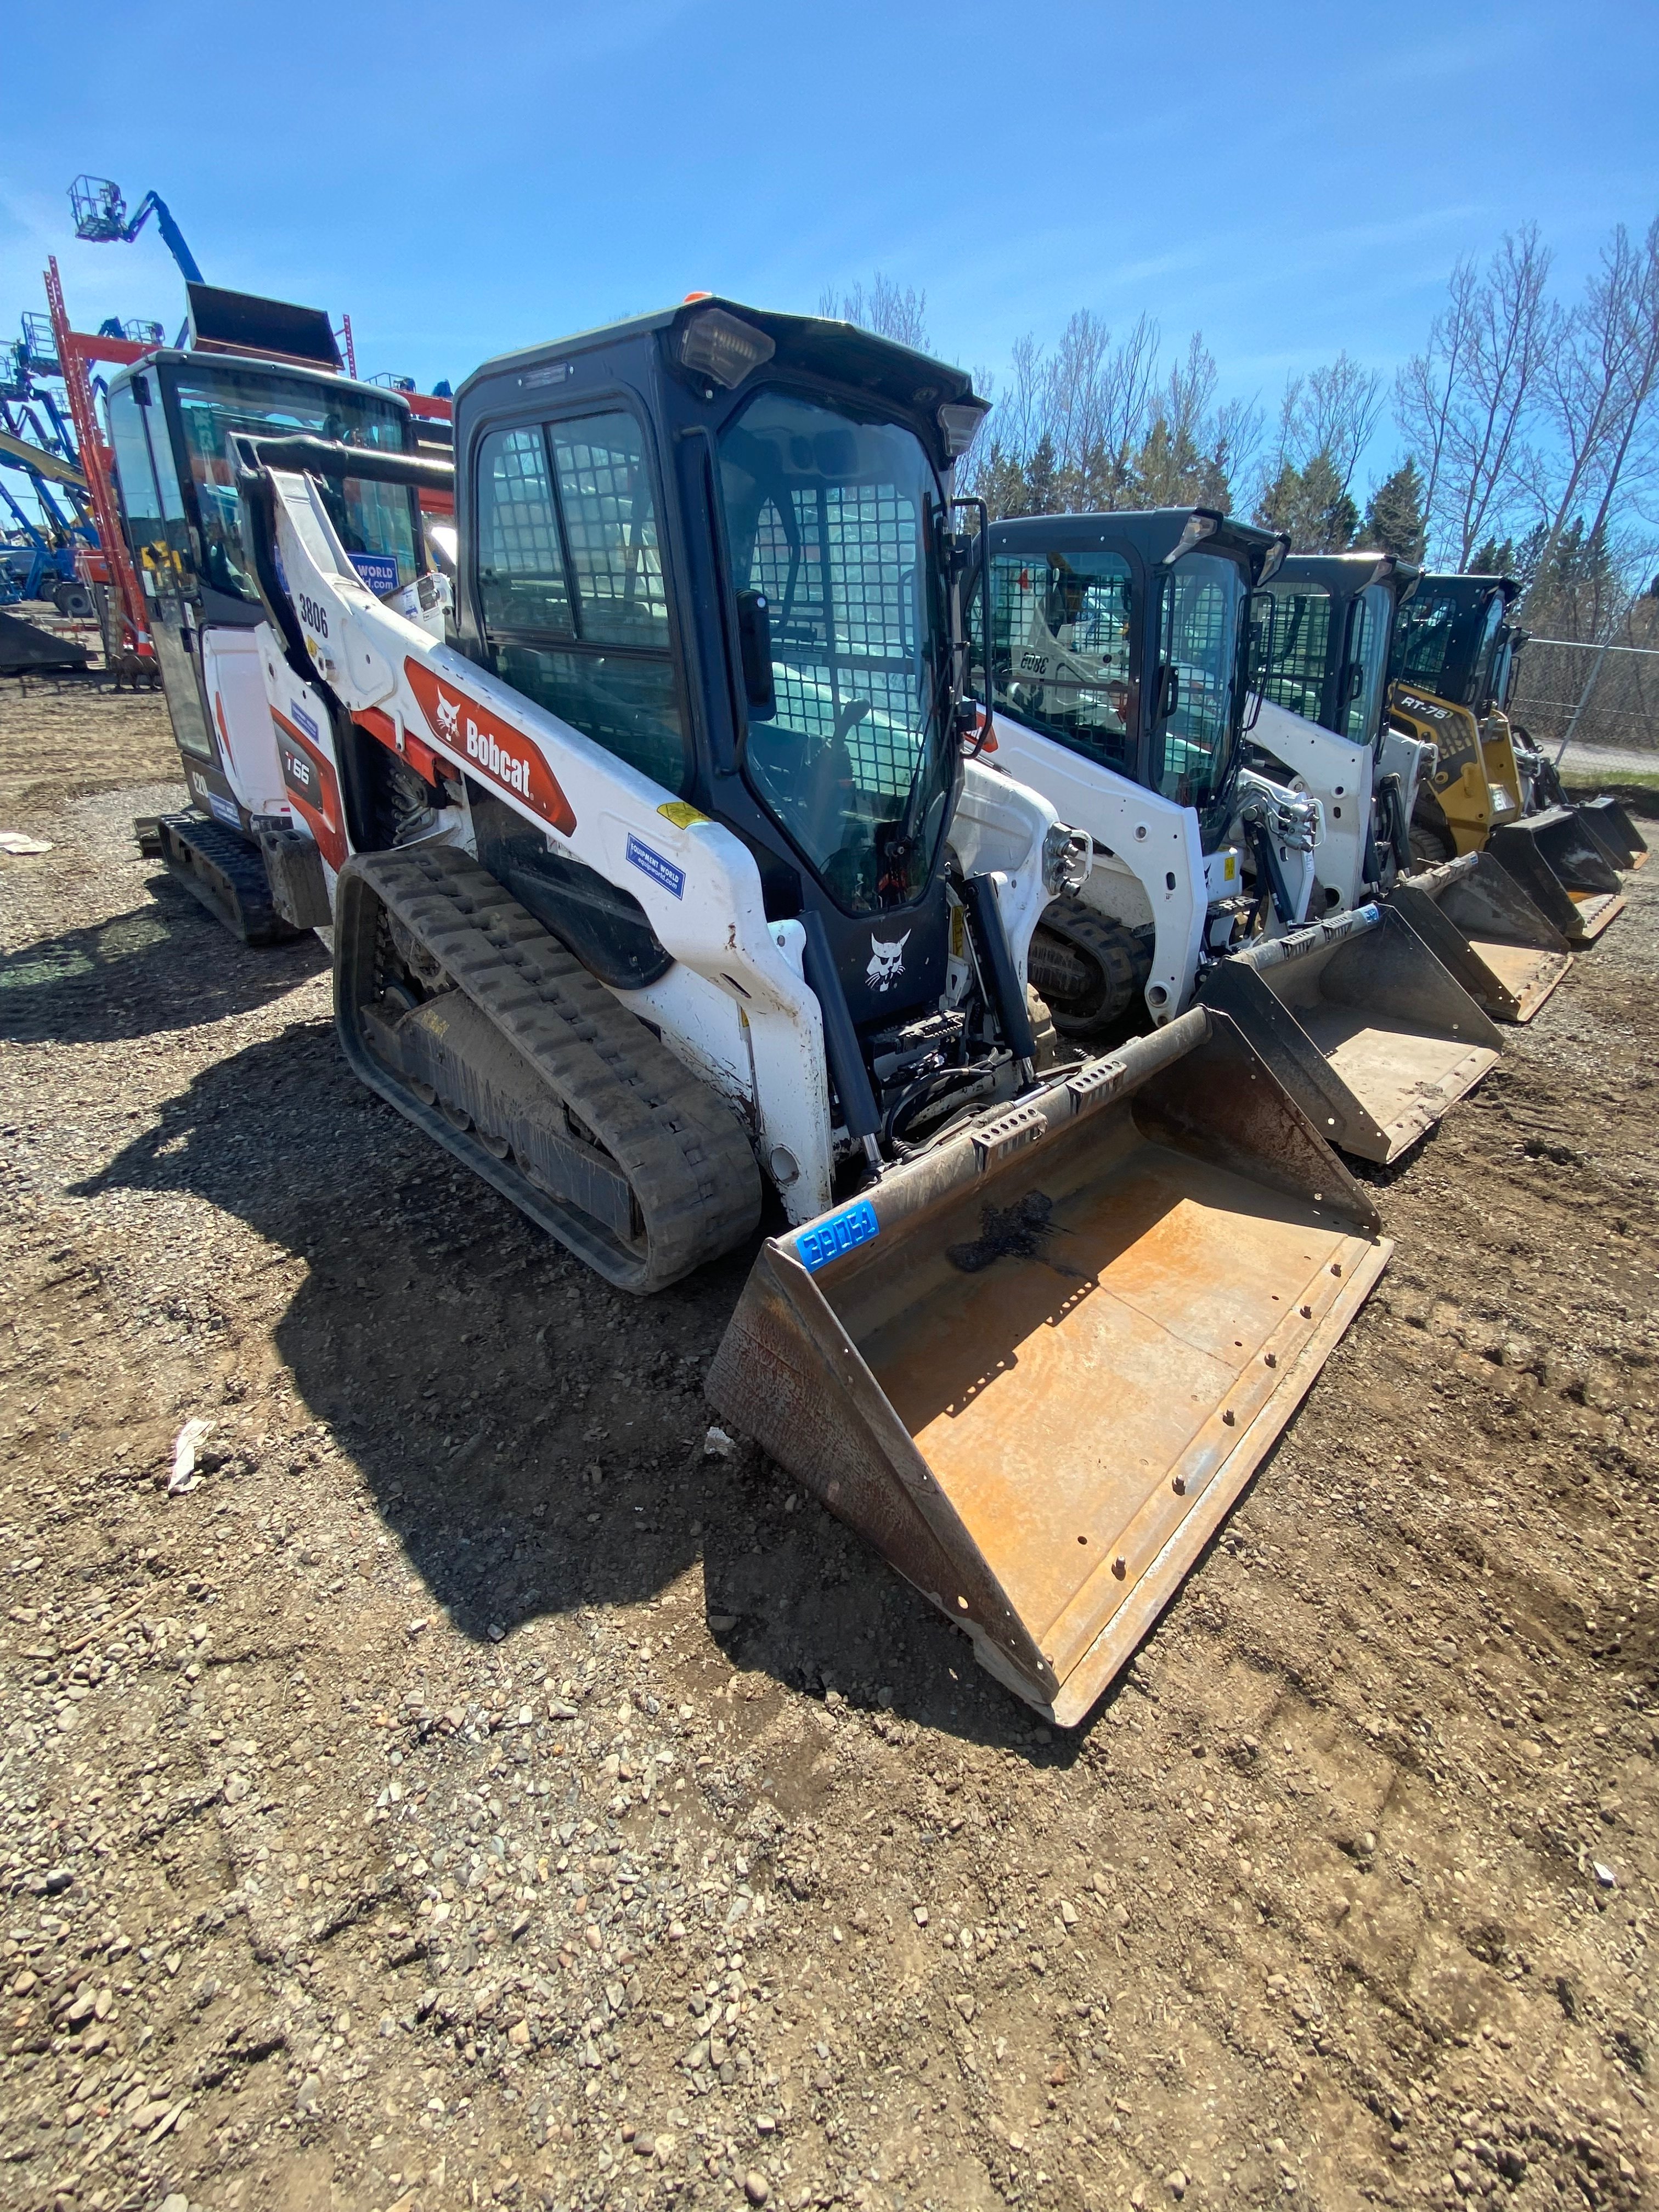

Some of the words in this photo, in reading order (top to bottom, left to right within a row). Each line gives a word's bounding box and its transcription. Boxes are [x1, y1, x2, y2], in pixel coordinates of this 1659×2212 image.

[358, 565, 393, 579] WORLD
[299, 592, 329, 639] 3806
[1401, 696, 1448, 719] RT-75
[467, 718, 531, 798] Bobcat
[631, 842, 659, 868] EQUIPMENT
[660, 864, 680, 883] WORLD
[637, 857, 678, 889] equipworld.com
